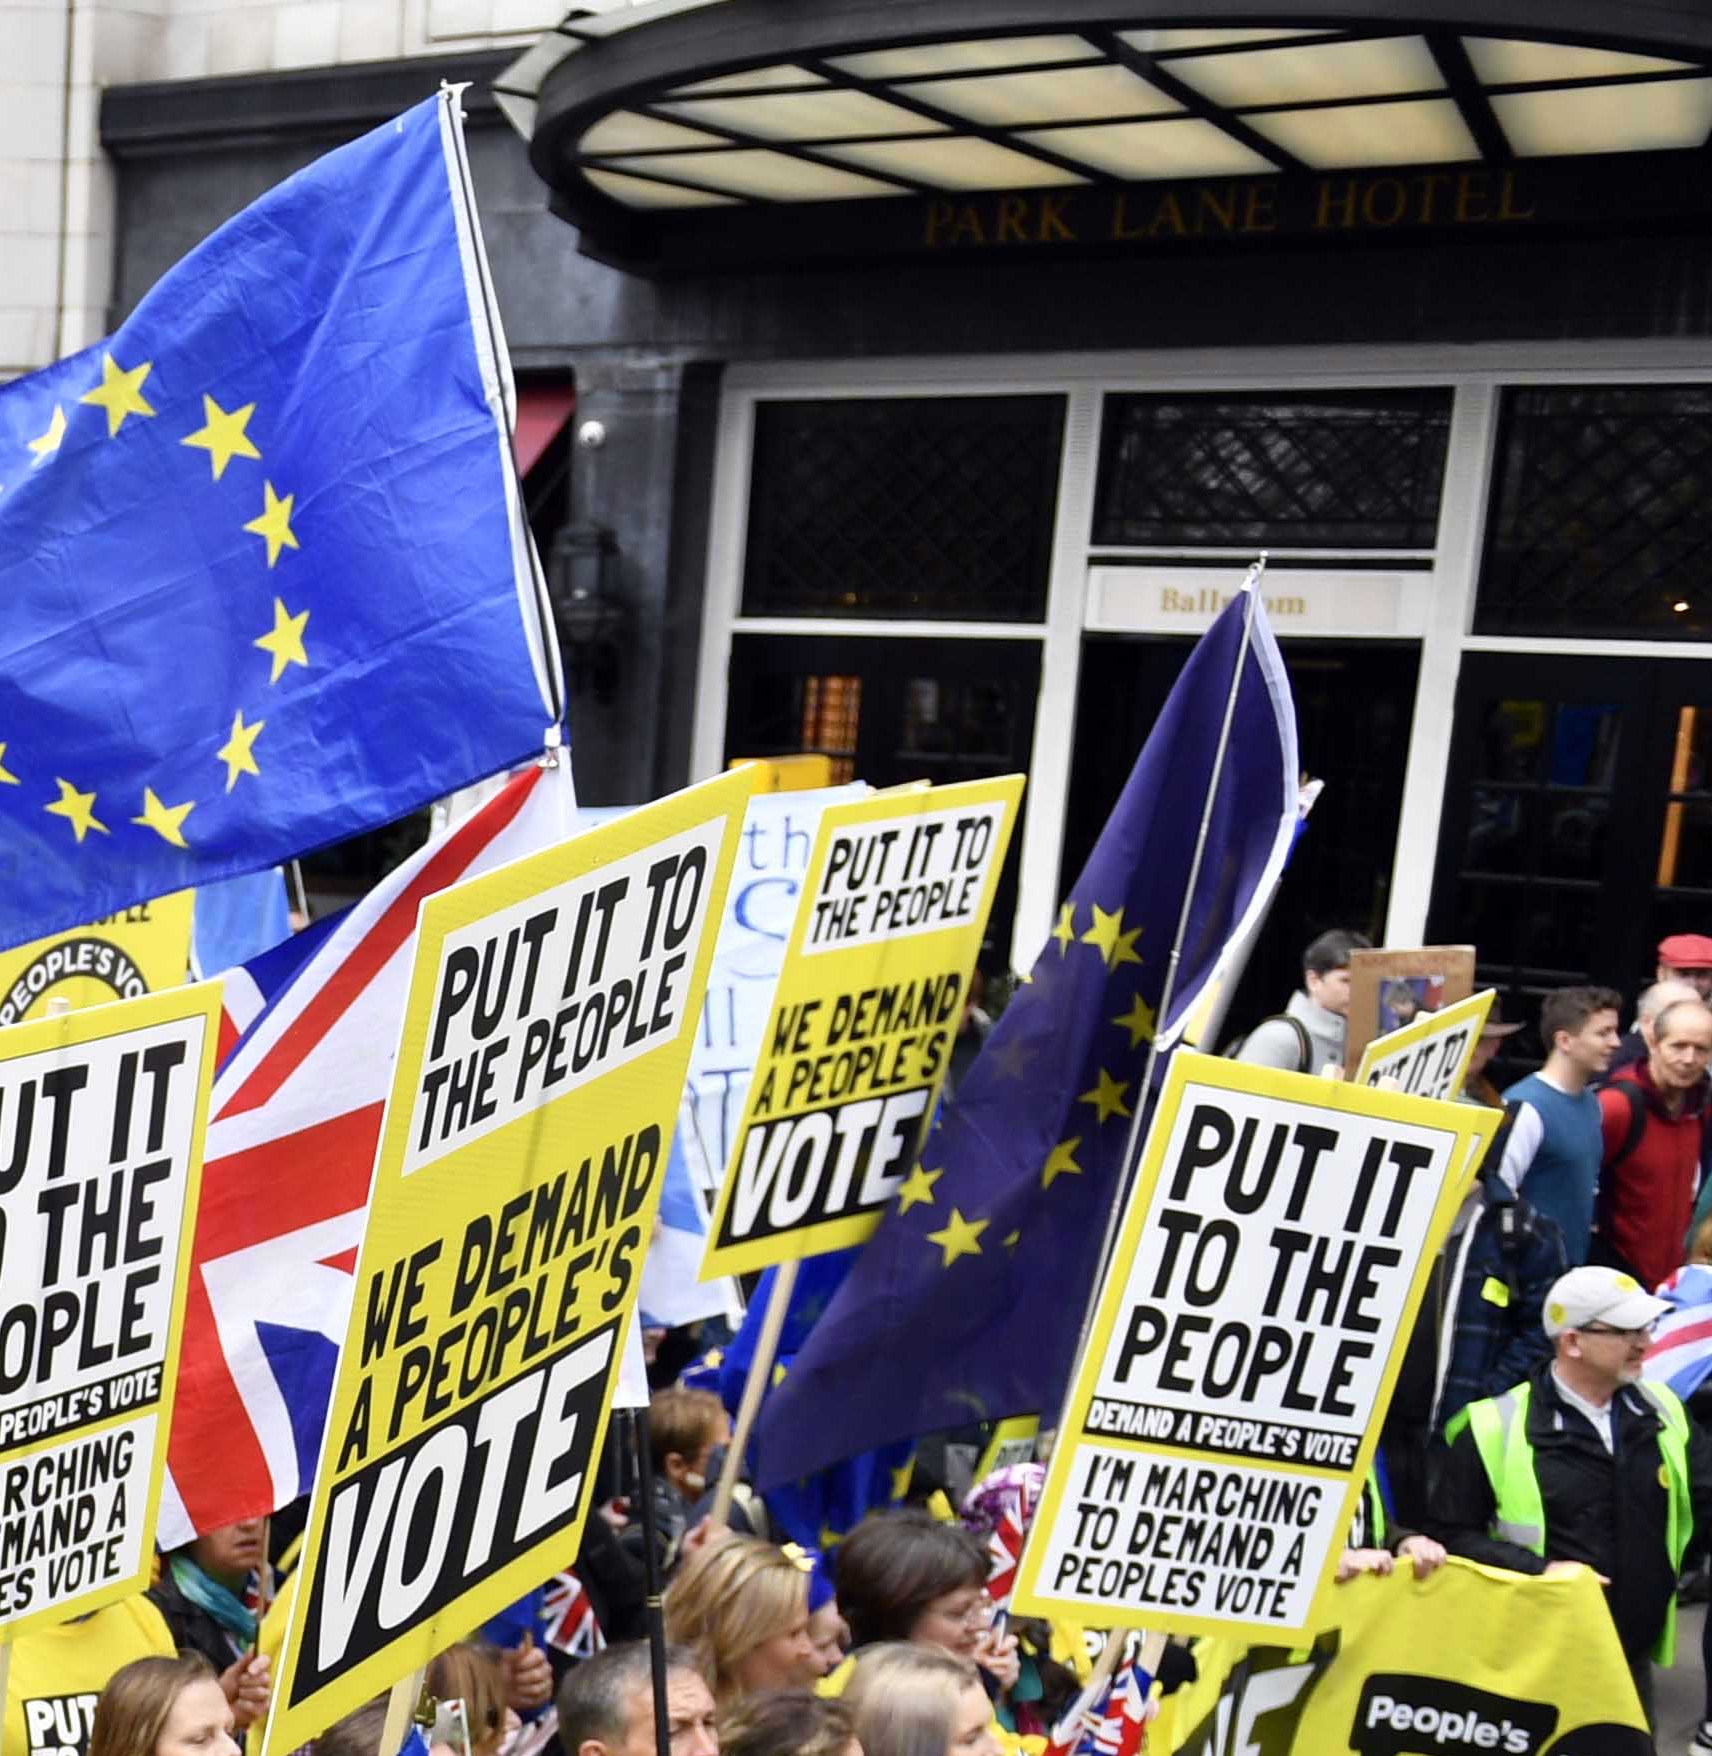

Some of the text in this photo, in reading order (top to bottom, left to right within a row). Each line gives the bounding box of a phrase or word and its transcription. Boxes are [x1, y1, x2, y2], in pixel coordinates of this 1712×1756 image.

[924, 173, 1537, 248] PARK LANE HOTEL
[821, 812, 992, 898] PUT IT TO
[430, 844, 709, 1064] PUT IT TO
[811, 873, 980, 947] THE PEOPLE
[416, 951, 687, 1153] THE PEOPLE
[772, 970, 961, 1060] WE DEMAND
[787, 1030, 946, 1109] PEOPLE'S
[727, 1088, 930, 1241] VOTE
[1167, 1102, 1436, 1240] PUT IT
[362, 1121, 663, 1369] WE DEMAND
[1150, 1206, 1403, 1334] TO THE
[387, 1227, 634, 1438] PEOPLE'S
[1112, 1304, 1375, 1419] PEOPLE
[1088, 1399, 1358, 1465] DEMAND PEOPLE'S VOTE
[316, 1327, 616, 1673] VOTE
[1081, 1455, 1323, 1529] I'M MARCHING
[1074, 1502, 1280, 1573] TO DEMAND
[1053, 1552, 1297, 1620] PEOPLES VOTE
[1366, 1694, 1530, 1755] People's
